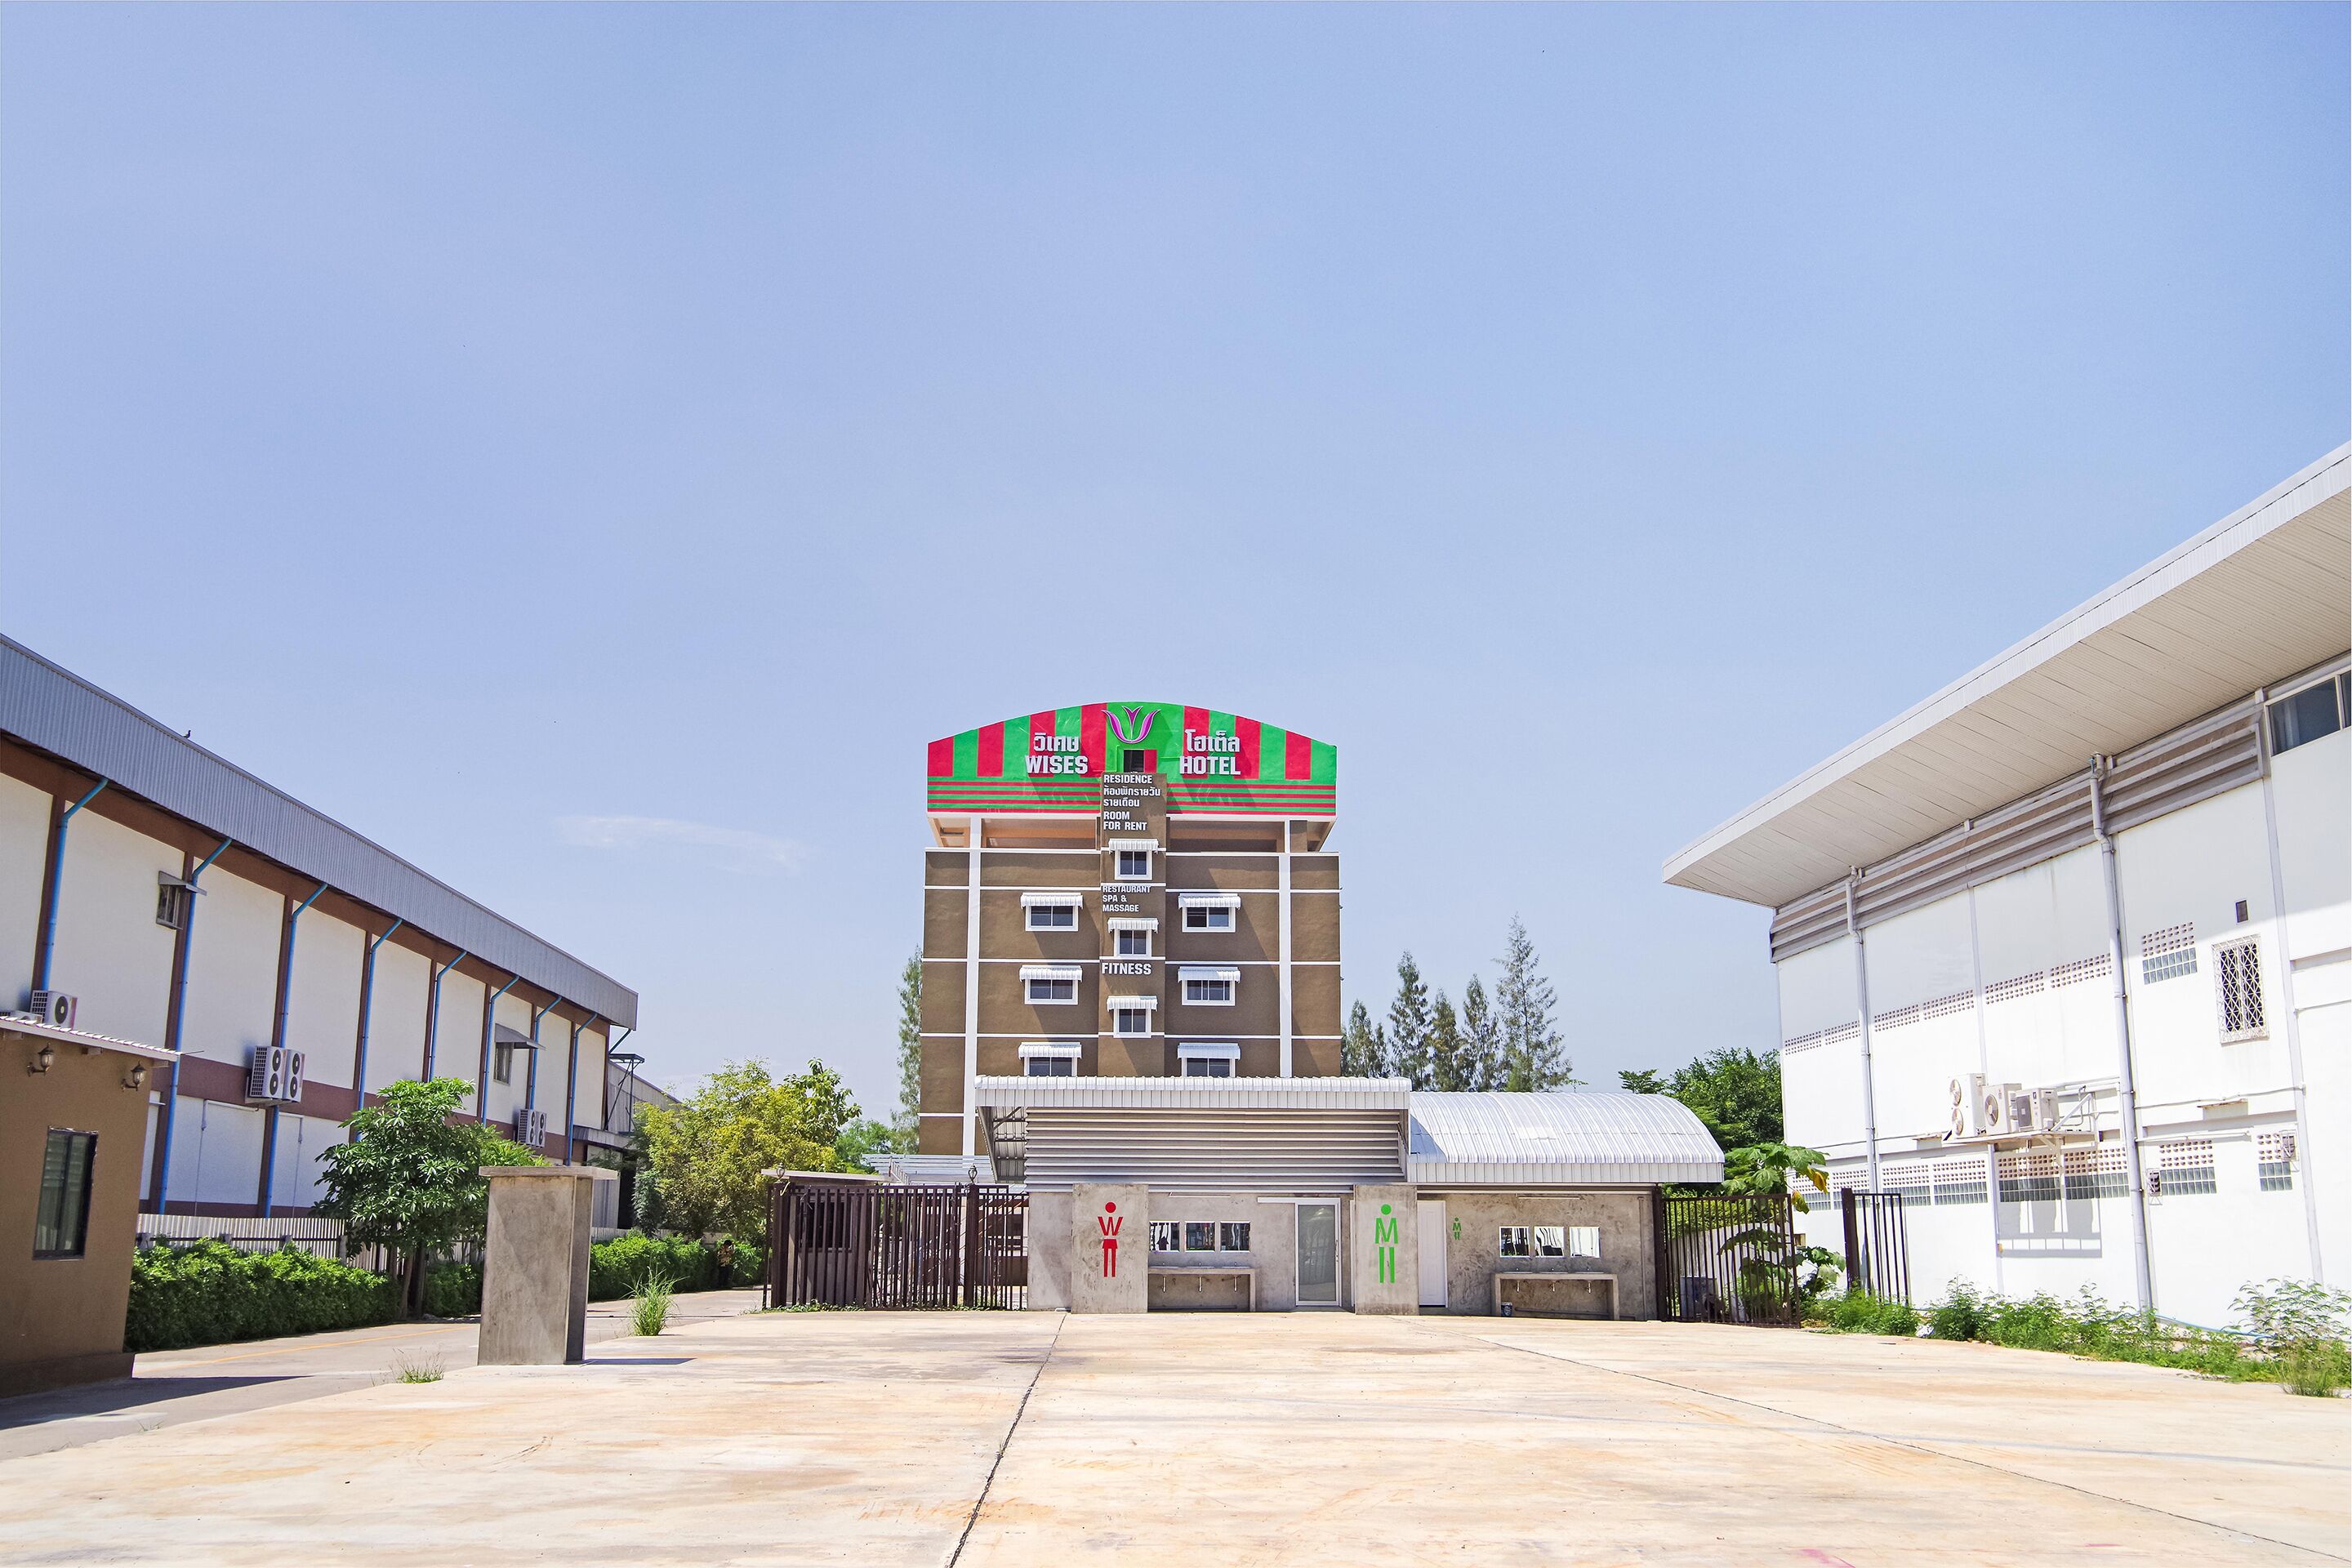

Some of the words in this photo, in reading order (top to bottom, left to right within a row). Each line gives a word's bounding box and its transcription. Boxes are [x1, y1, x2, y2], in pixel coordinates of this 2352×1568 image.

[1025, 755, 1089, 774] WISES
[1179, 755, 1241, 775] HOTEL
[1103, 774, 1153, 784] RESIDENCE
[1103, 785, 1161, 796] ห้องพักรายวัน
[1103, 811, 1130, 820] ROOM
[1103, 821, 1121, 831] FOR
[1125, 822, 1147, 831] RENT
[1102, 884, 1152, 893] RESTAURANT
[1102, 894, 1118, 902] SPA
[1120, 894, 1128, 902] &
[1102, 904, 1139, 912] MASSAGE
[1102, 963, 1152, 975] FITNESS
[1098, 1217, 1123, 1236] W
[1374, 1218, 1399, 1244] M
